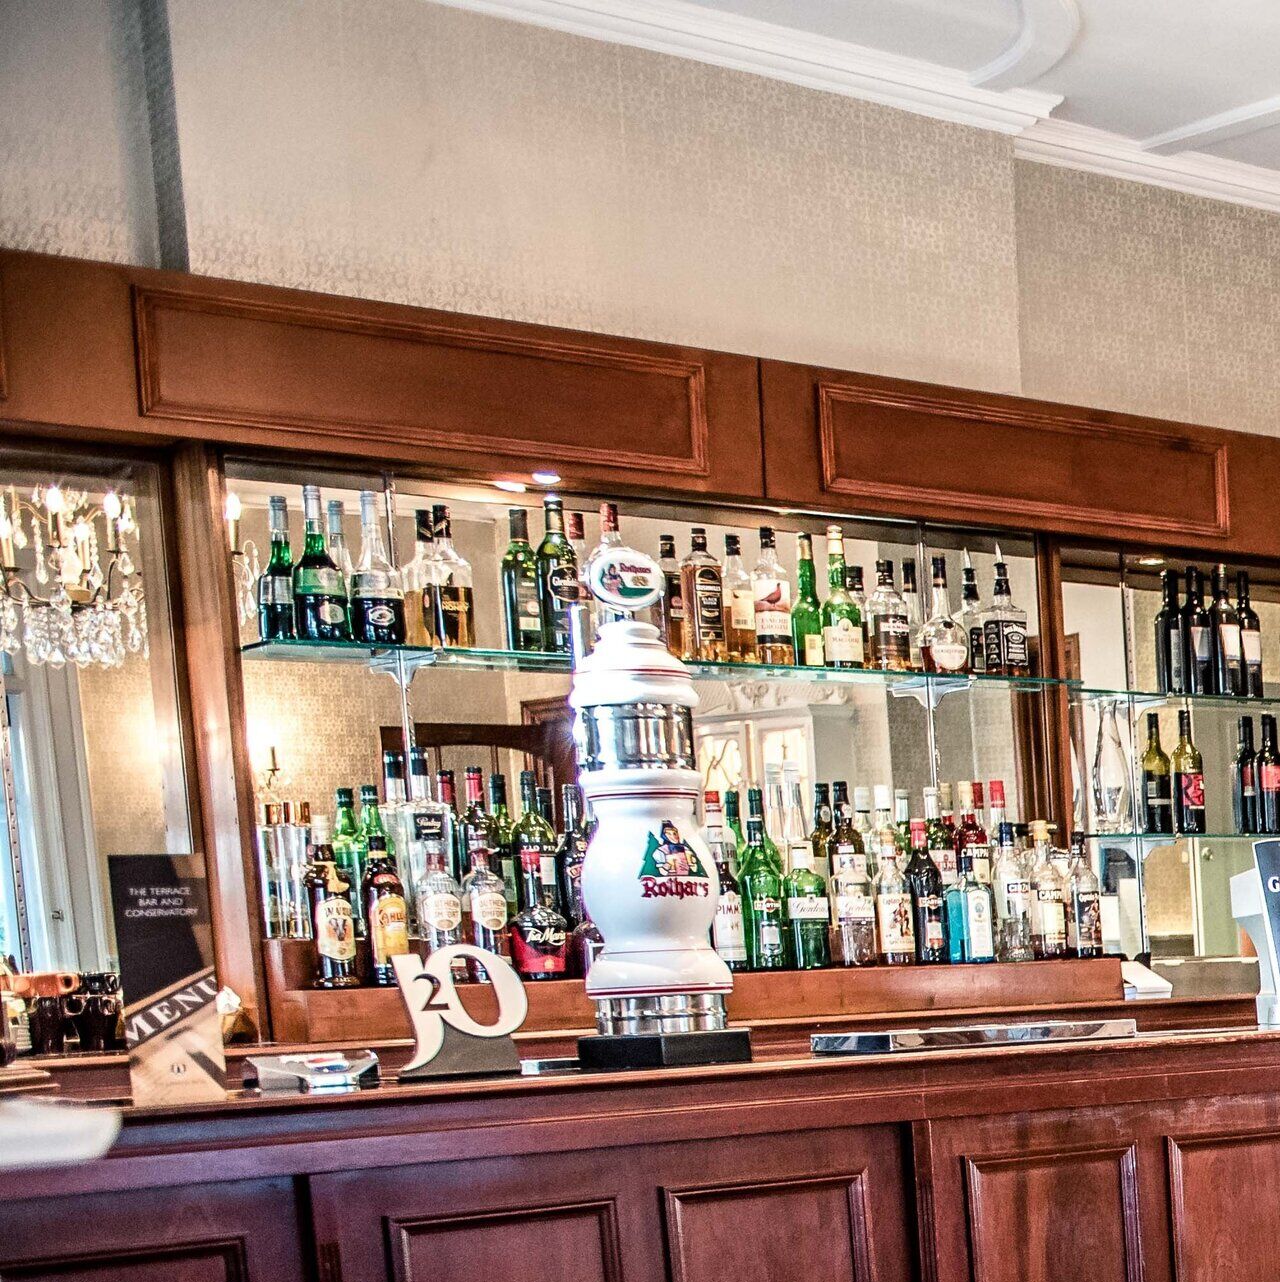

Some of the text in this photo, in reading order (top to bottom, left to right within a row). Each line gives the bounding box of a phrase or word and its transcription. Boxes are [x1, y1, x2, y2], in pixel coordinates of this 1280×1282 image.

[128, 887, 191, 896] THE TERRACE
[138, 897, 184, 906] BAR AND
[124, 907, 199, 918] CONSERVATORY
